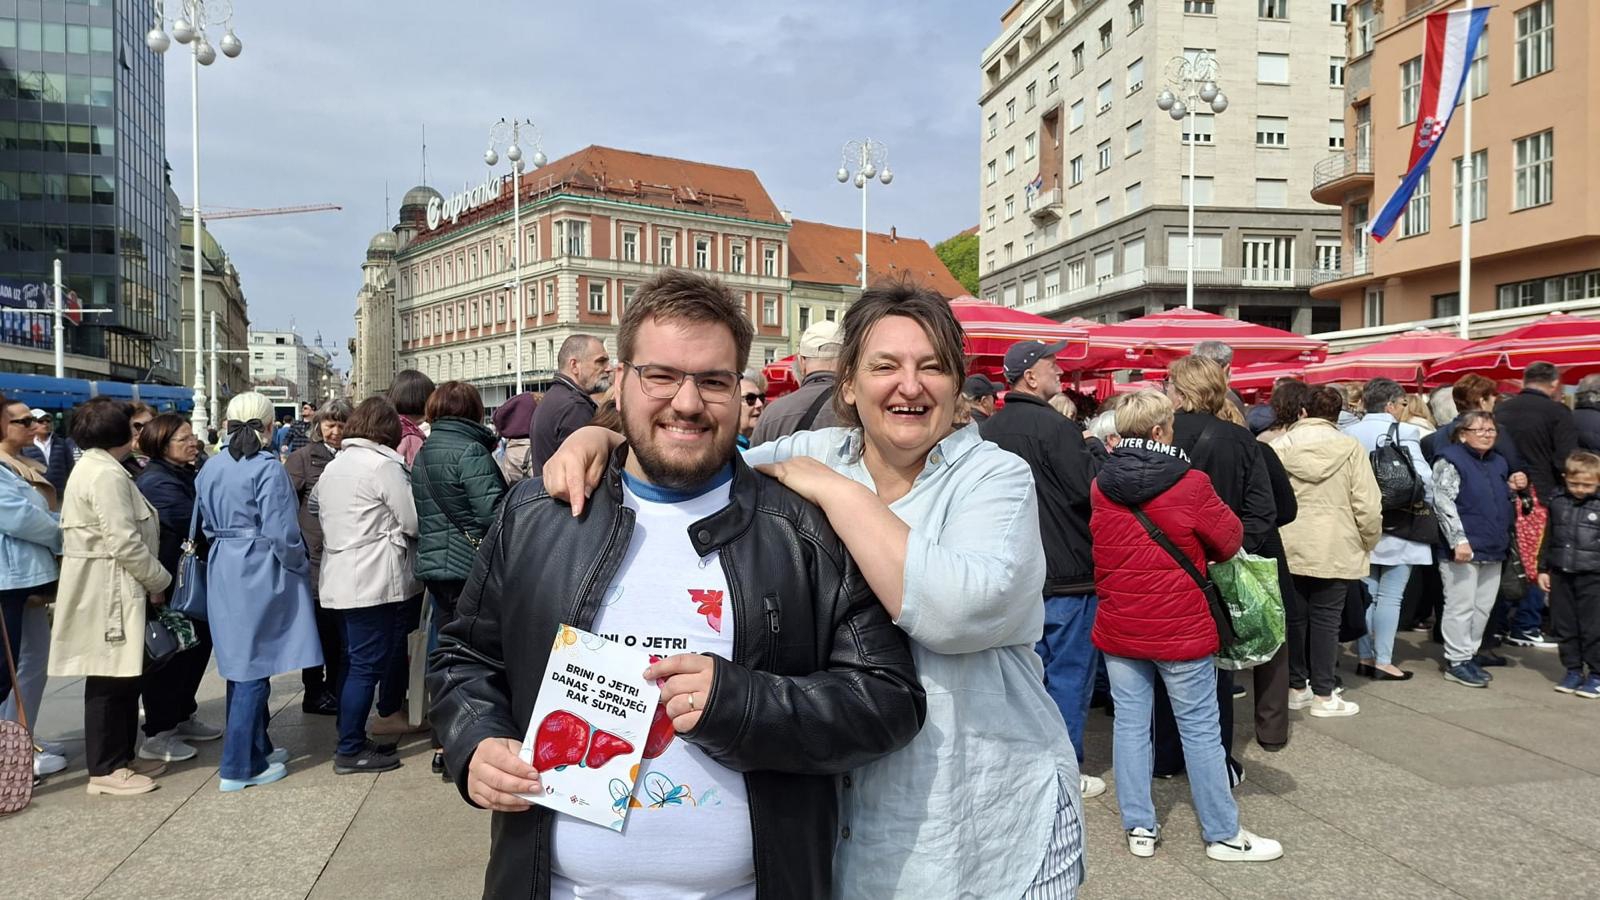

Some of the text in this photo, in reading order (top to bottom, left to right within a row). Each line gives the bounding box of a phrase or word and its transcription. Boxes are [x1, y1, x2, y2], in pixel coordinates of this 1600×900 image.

[1146, 440, 1177, 456] GAME
[624, 635, 637, 647] O
[642, 636, 687, 650] JETRI
[551, 671, 589, 693] DANAS
[598, 689, 647, 714] SPRIJEČI
[566, 663, 640, 697] BRINI O JETRI
[566, 689, 627, 719] RAK SUTRA
